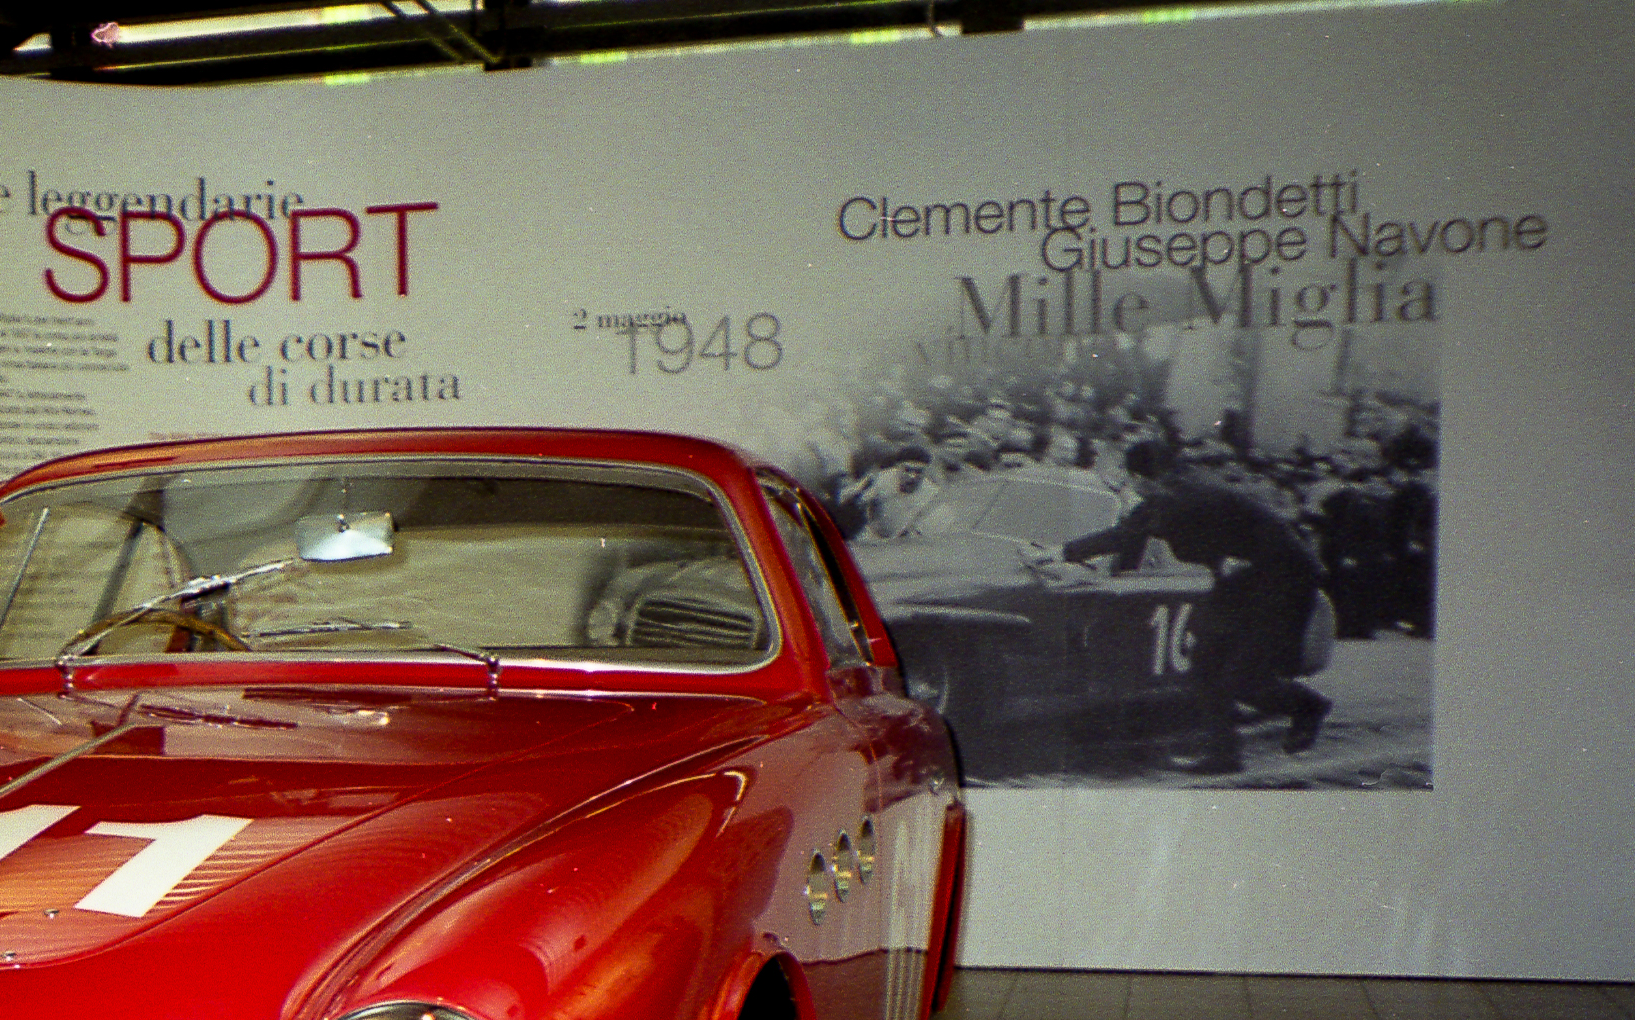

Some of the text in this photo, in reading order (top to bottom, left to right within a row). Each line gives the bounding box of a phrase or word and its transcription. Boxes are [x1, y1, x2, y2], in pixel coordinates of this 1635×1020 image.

[28, 171, 305, 234] leggendarie
[837, 168, 1358, 241] Clemente Biondetti
[43, 202, 439, 304] SPORT
[1041, 212, 1548, 272] Giuseppe Navone
[573, 306, 687, 331] 2 maggio
[955, 257, 1440, 350] Mille Miglia
[147, 320, 407, 365] delle corse
[615, 311, 783, 375] 1948
[247, 366, 463, 407] di durata
